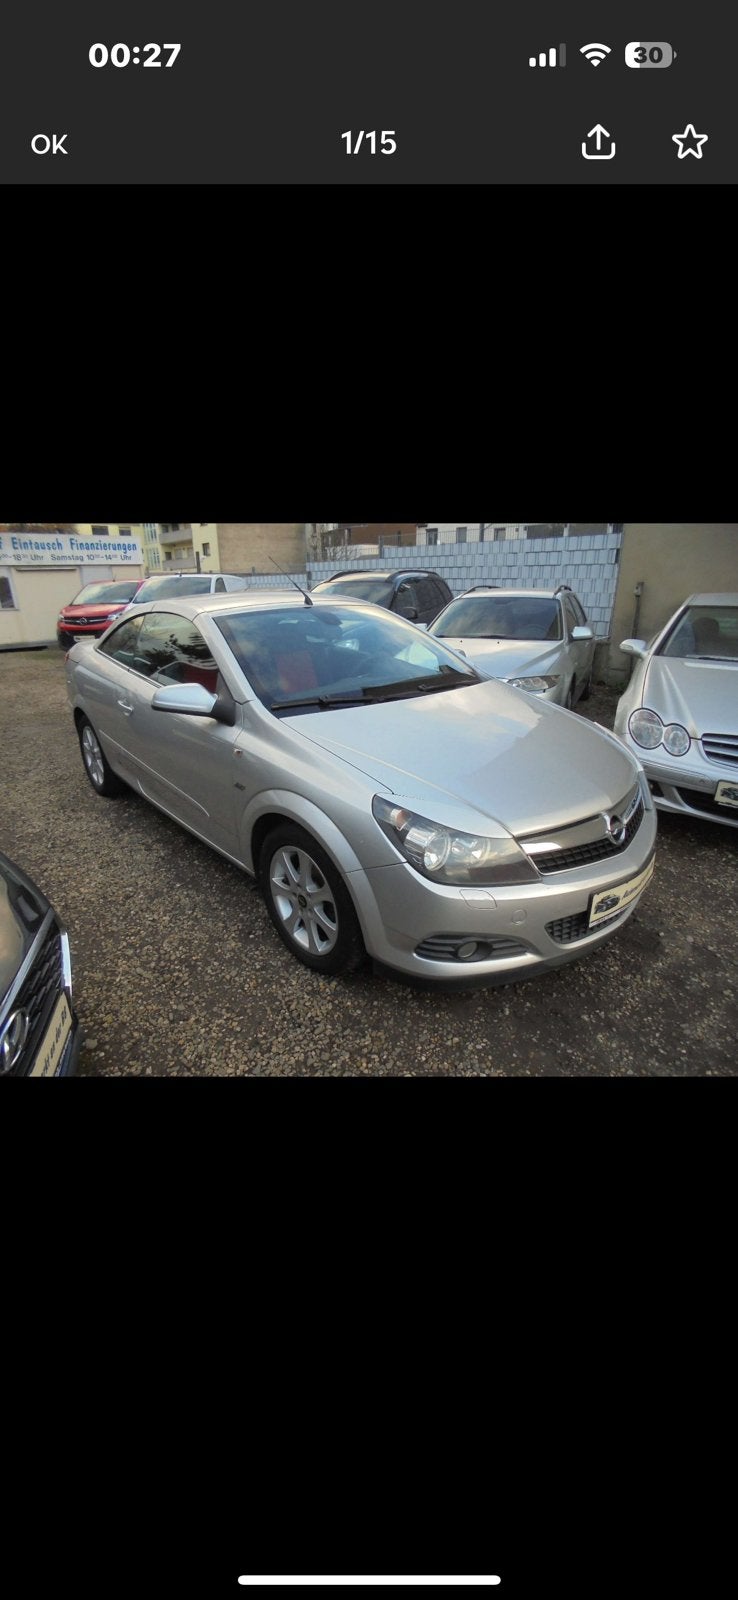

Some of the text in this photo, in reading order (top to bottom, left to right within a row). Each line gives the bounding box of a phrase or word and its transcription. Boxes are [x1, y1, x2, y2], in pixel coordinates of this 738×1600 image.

[11, 536, 63, 550] Eintausch
[69, 537, 137, 554] Finanzierungen
[30, 553, 44, 561] Uhr
[50, 553, 84, 562] Samstag
[120, 553, 132, 561] Uhr
